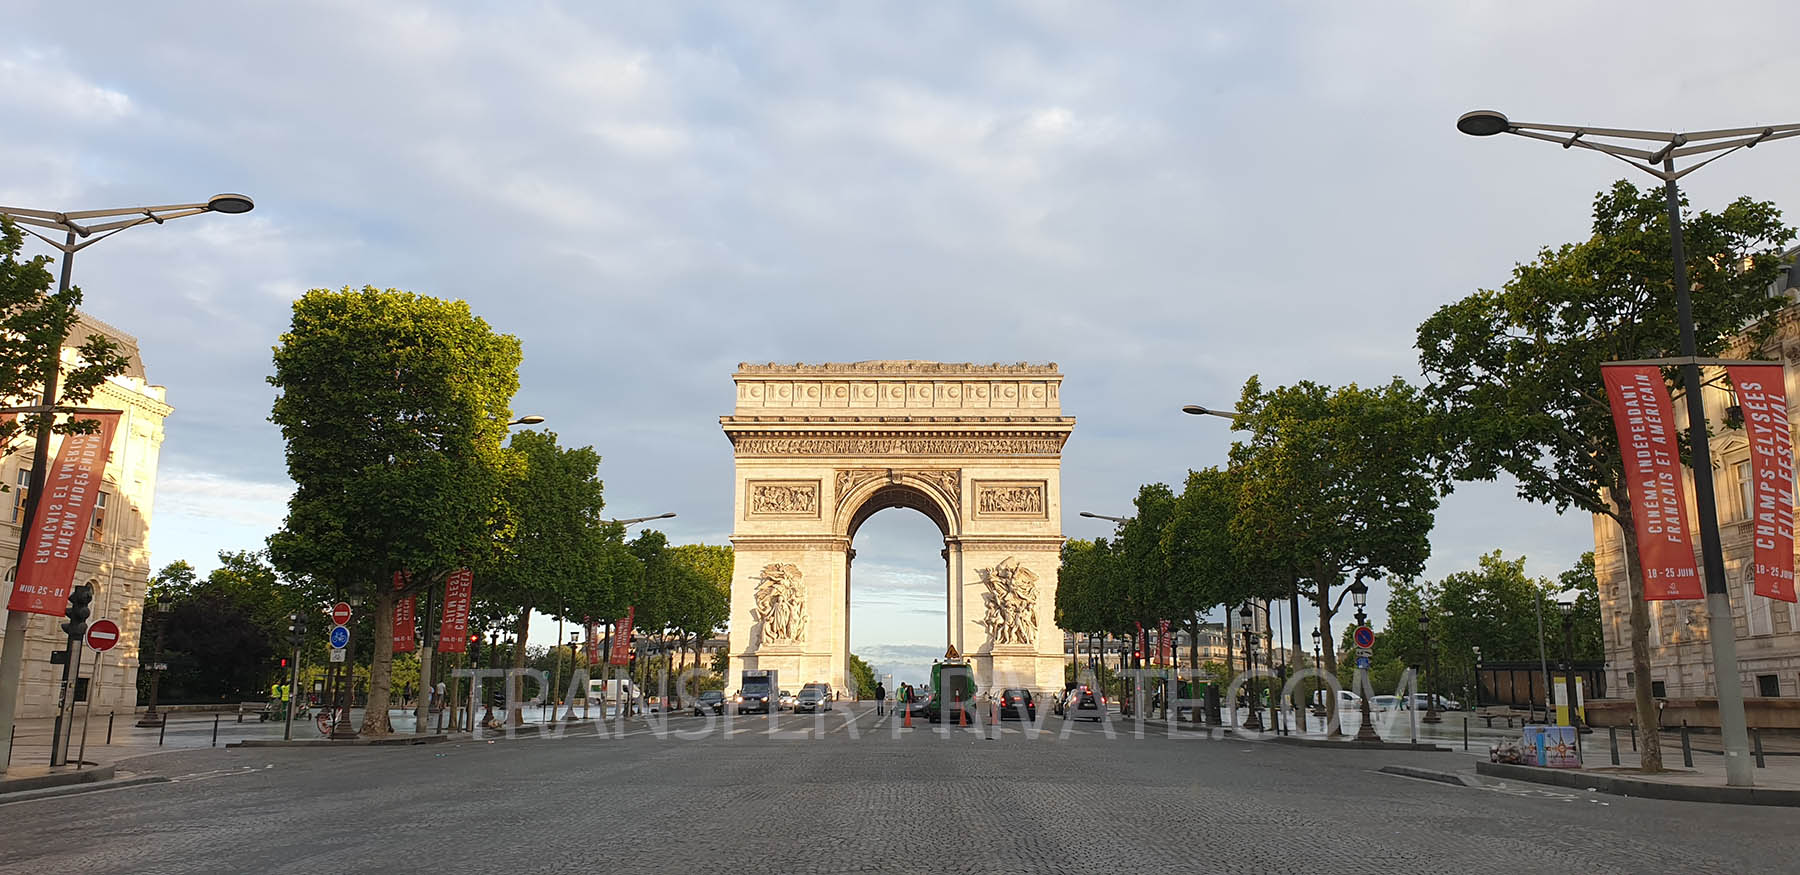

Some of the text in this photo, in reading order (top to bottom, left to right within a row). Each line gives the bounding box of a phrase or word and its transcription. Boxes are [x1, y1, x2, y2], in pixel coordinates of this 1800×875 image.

[1634, 374, 1666, 444] AMÉRICAIN
[1620, 384, 1662, 534] CINÉMA INDÉPENDANT
[1655, 449, 1671, 466] ET
[1741, 382, 1776, 550] CHAMPS-ÉLYSÉES
[1768, 394, 1794, 540] FILM FESTIVAL
[1647, 568, 1657, 579] 18
[1665, 567, 1675, 578] 25
[1676, 567, 1694, 577] JUIN
[1770, 566, 1779, 577] 25
